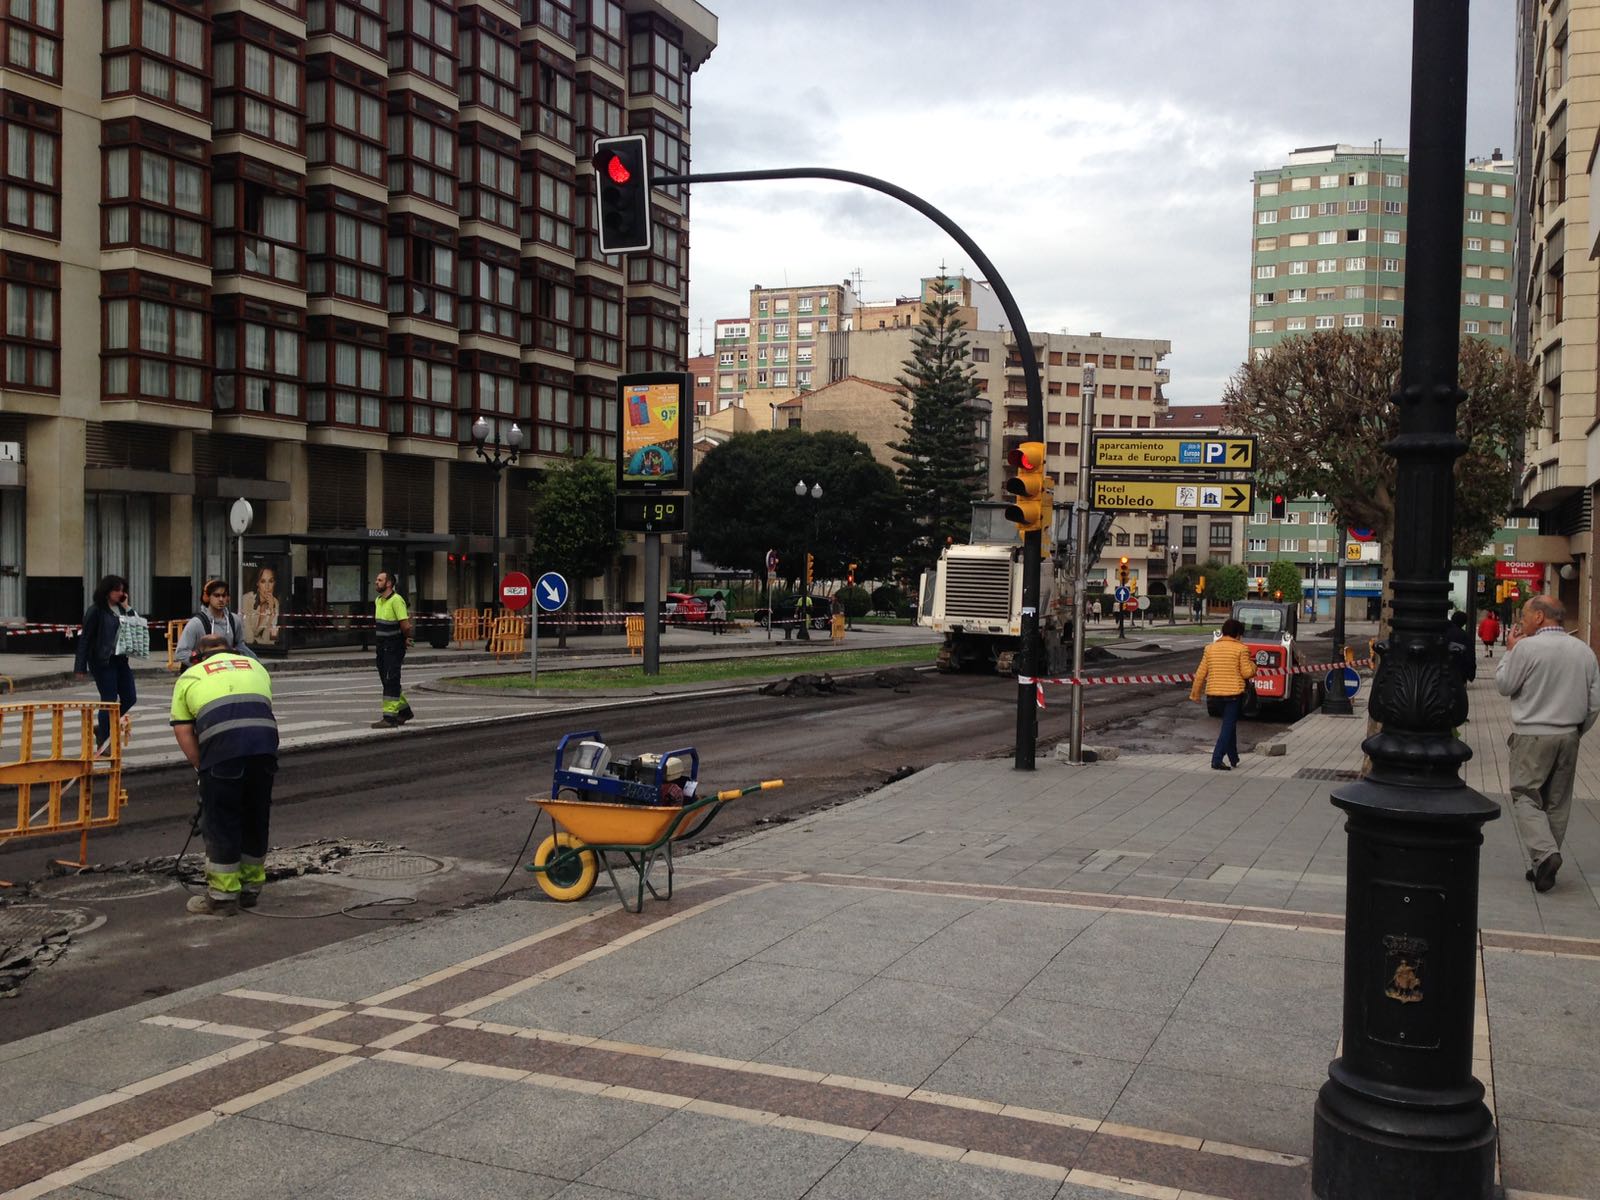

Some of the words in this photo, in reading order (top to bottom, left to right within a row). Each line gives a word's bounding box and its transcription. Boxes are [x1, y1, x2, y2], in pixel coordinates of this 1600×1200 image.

[1099, 441, 1164, 451] aparcamiento
[1099, 452, 1123, 461] Plaza
[1127, 453, 1139, 462] de
[1143, 453, 1177, 464] Europa
[1206, 443, 1223, 463] P
[1097, 484, 1125, 493] Hotel
[1098, 494, 1154, 507] Robledo
